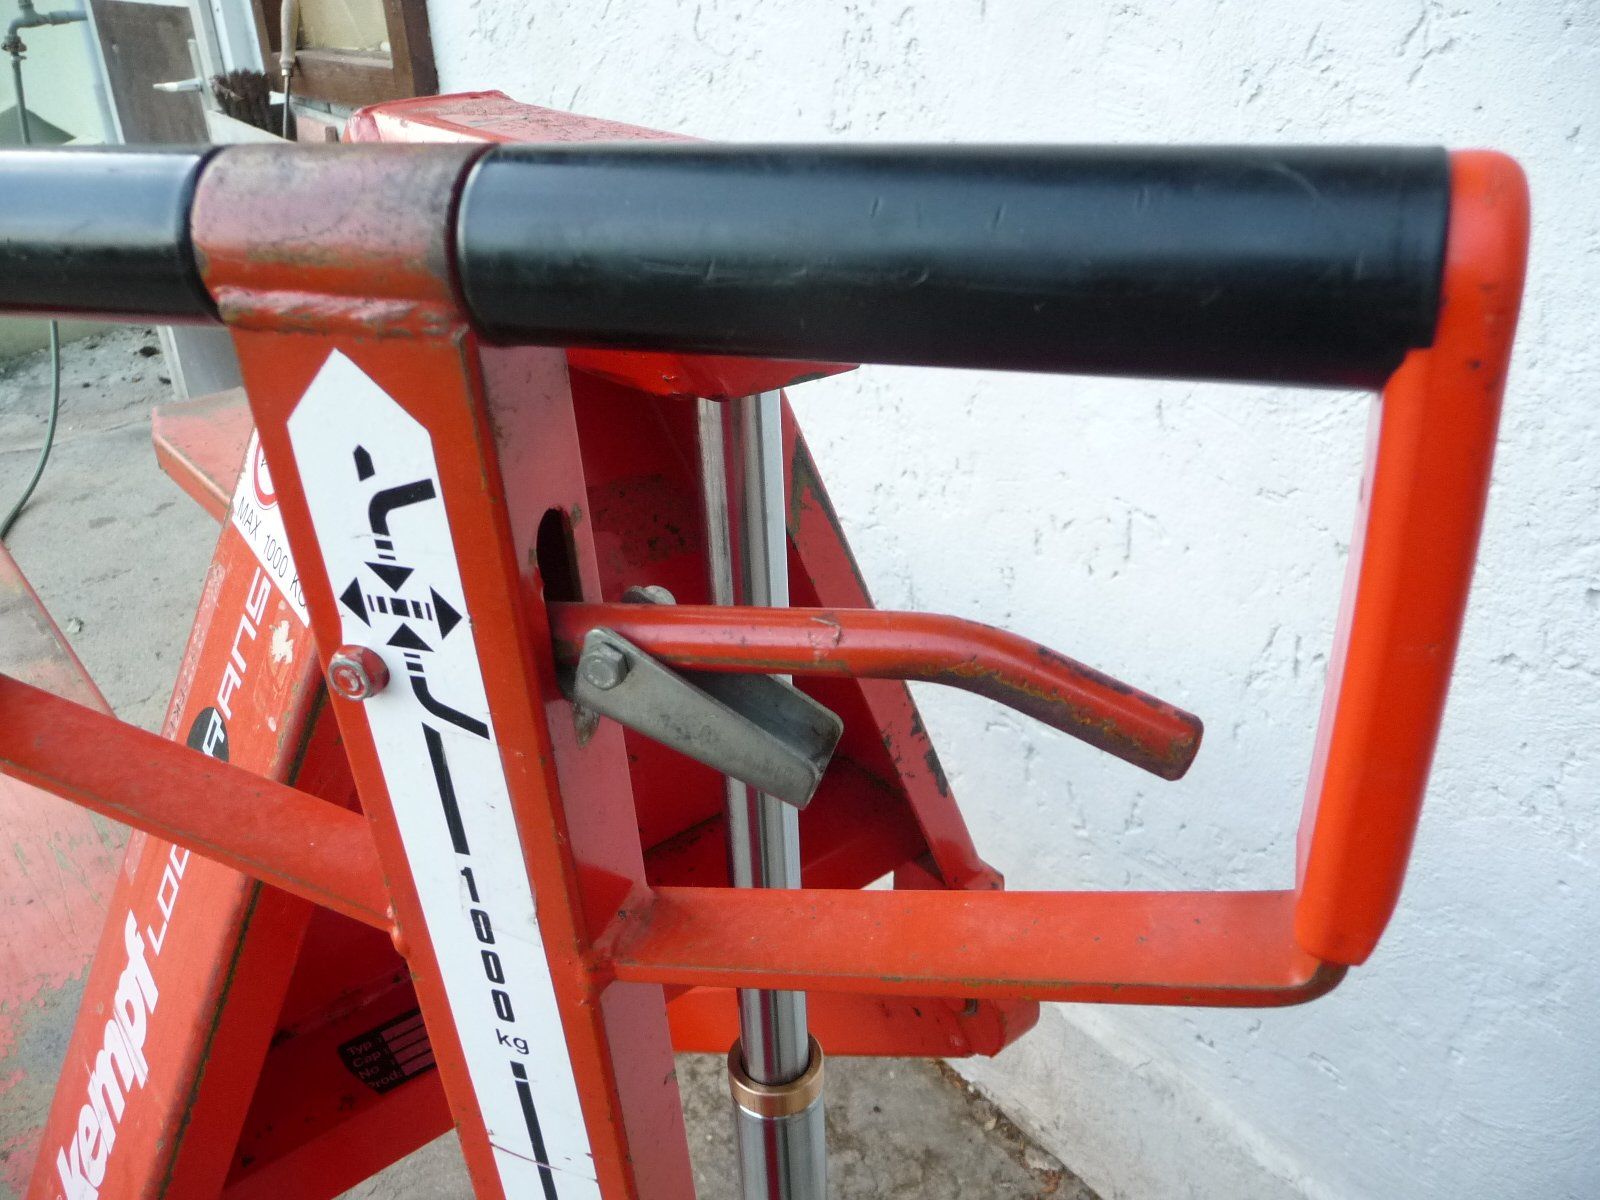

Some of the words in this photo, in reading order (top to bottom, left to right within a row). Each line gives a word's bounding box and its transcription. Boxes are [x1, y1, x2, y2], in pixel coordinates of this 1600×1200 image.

[237, 496, 262, 541] MAX
[264, 534, 289, 578] 1000
[460, 866, 516, 1023] 1000
[495, 1028, 530, 1055] kg
